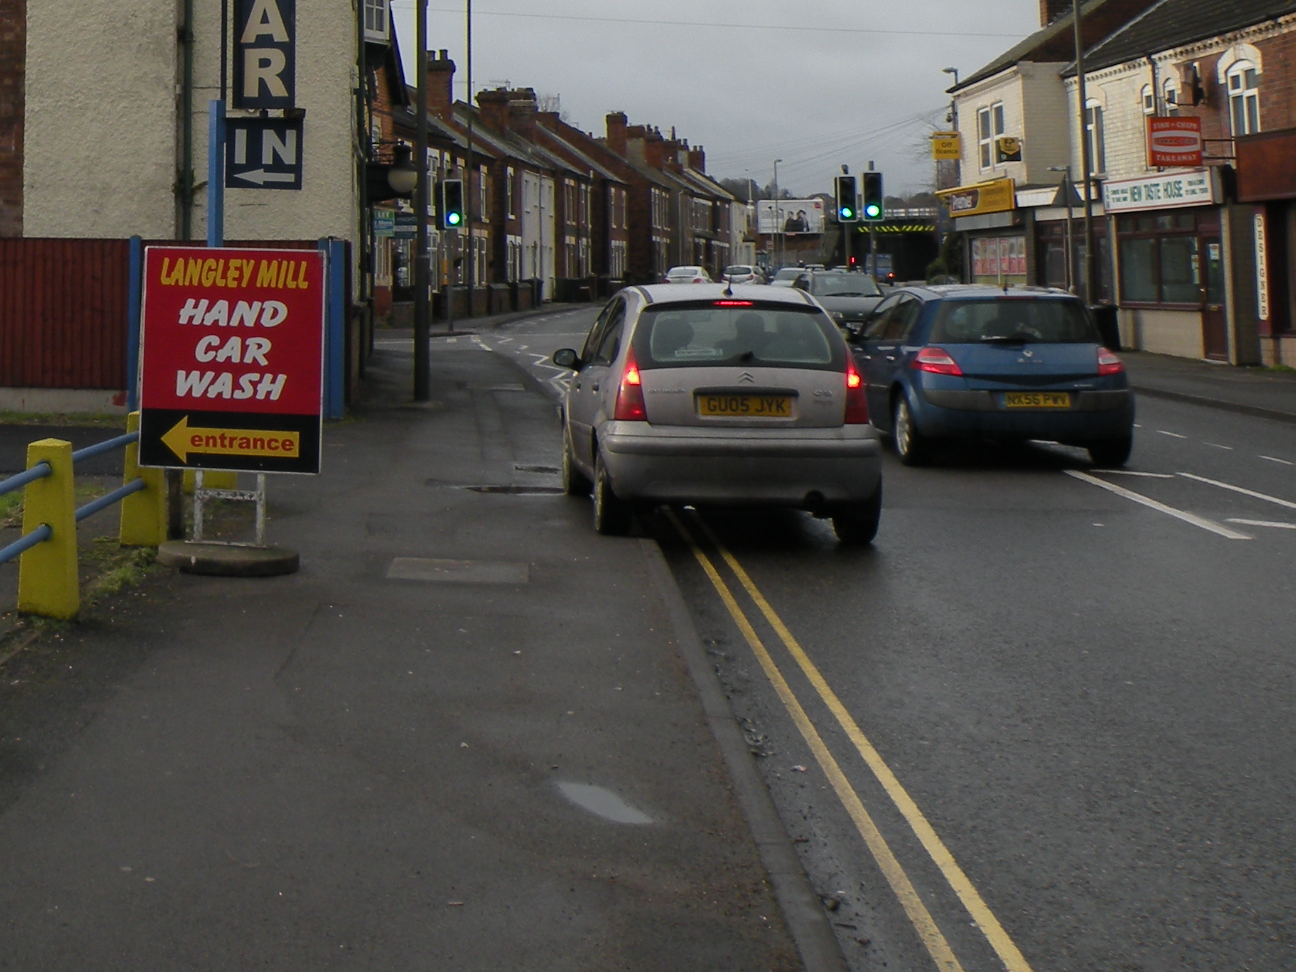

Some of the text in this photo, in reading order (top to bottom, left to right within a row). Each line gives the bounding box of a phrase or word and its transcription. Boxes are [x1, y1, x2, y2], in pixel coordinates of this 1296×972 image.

[234, 129, 296, 165] IN
[1155, 154, 1197, 162] TAKEAWAY
[1129, 185, 1143, 202] NEW
[1143, 182, 1162, 201] TASTE
[1162, 180, 1183, 199] HOUSE
[160, 257, 309, 289] LANGLEY MILL
[178, 298, 288, 328] HAND
[194, 335, 272, 366] CAR
[175, 370, 287, 401] WASH
[707, 397, 787, 413] GU05 JYK
[190, 432, 295, 452] entrance
